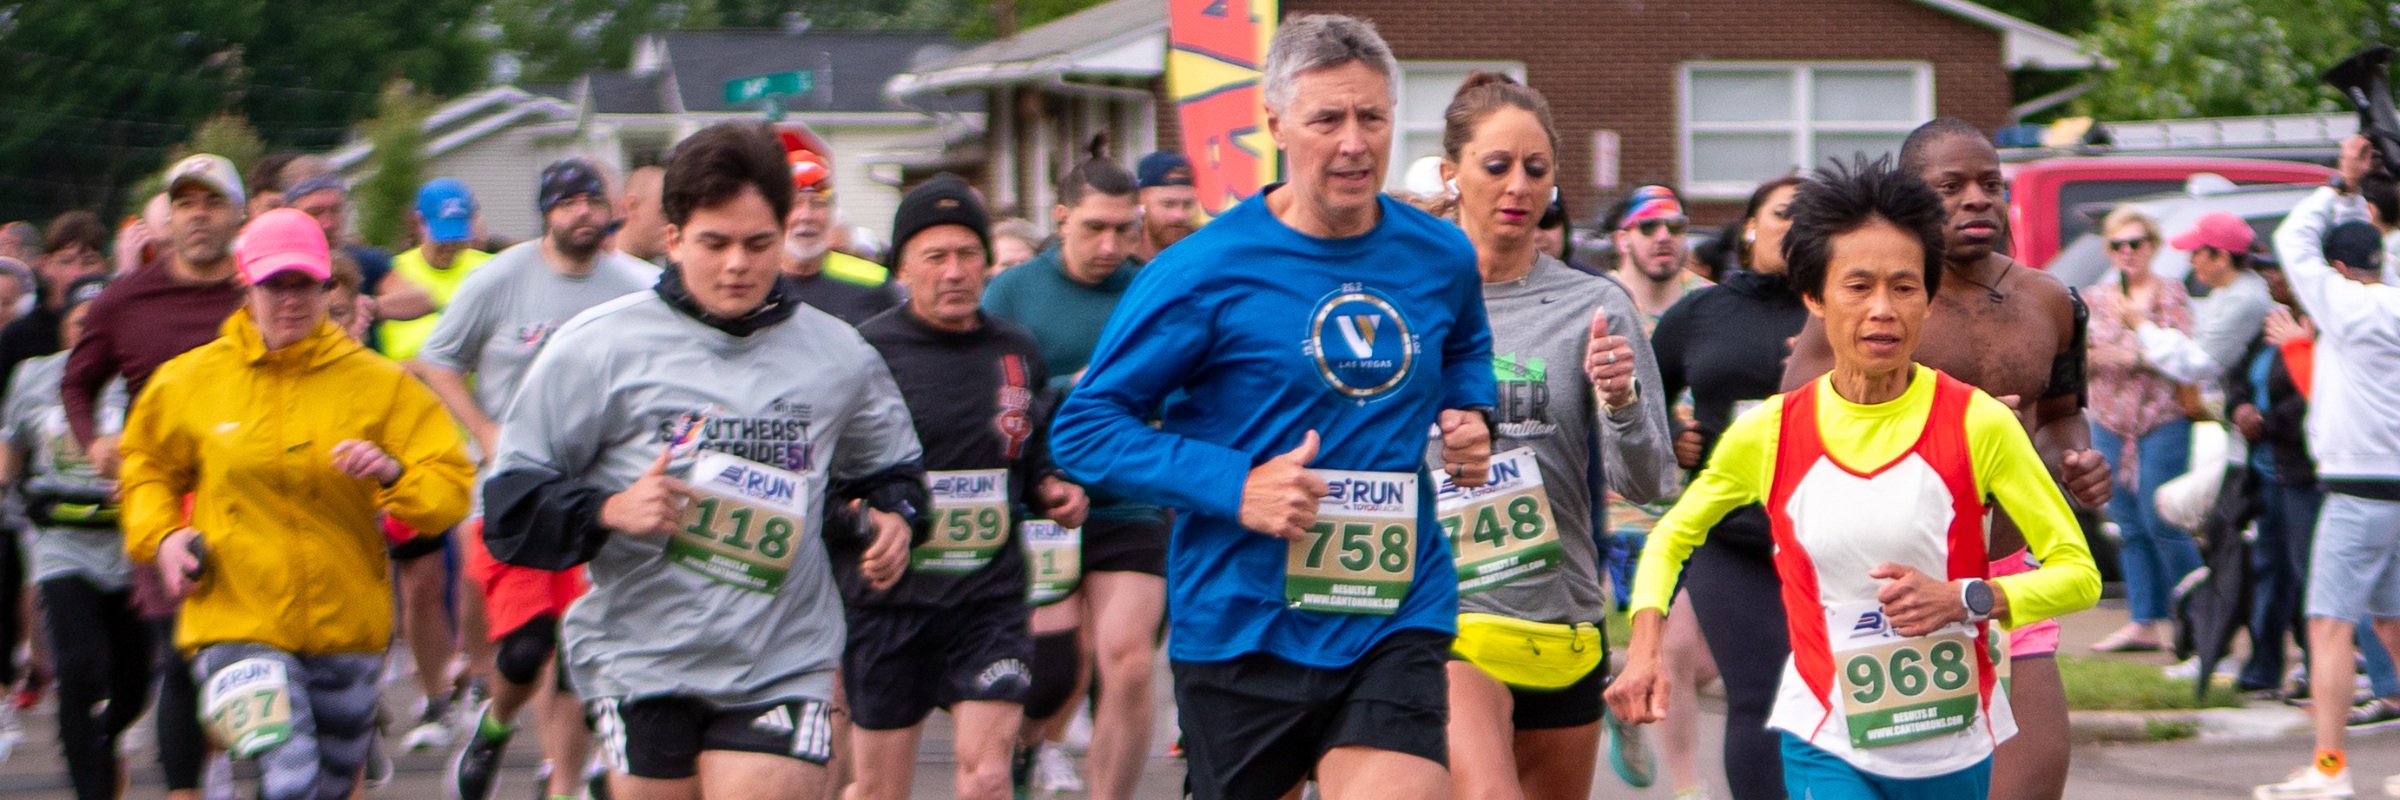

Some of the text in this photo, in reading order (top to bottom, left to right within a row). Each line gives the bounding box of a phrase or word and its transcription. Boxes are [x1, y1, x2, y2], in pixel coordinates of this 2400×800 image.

[1360, 360, 1392, 368] VEGAS
[746, 469, 796, 500] RUN
[955, 475, 996, 494] RUN
[1486, 458, 1520, 486] UN
[1353, 480, 1404, 505] RUN
[686, 497, 791, 559] 118
[1439, 495, 1545, 560] 748
[1304, 521, 1412, 573] 758
[1331, 583, 1378, 597] RESULTS AT
[1846, 640, 1970, 704] 968
[1867, 715, 1964, 741] WWW.CANTONRUNS.COM
[1893, 706, 1938, 724] RESULTS AT
